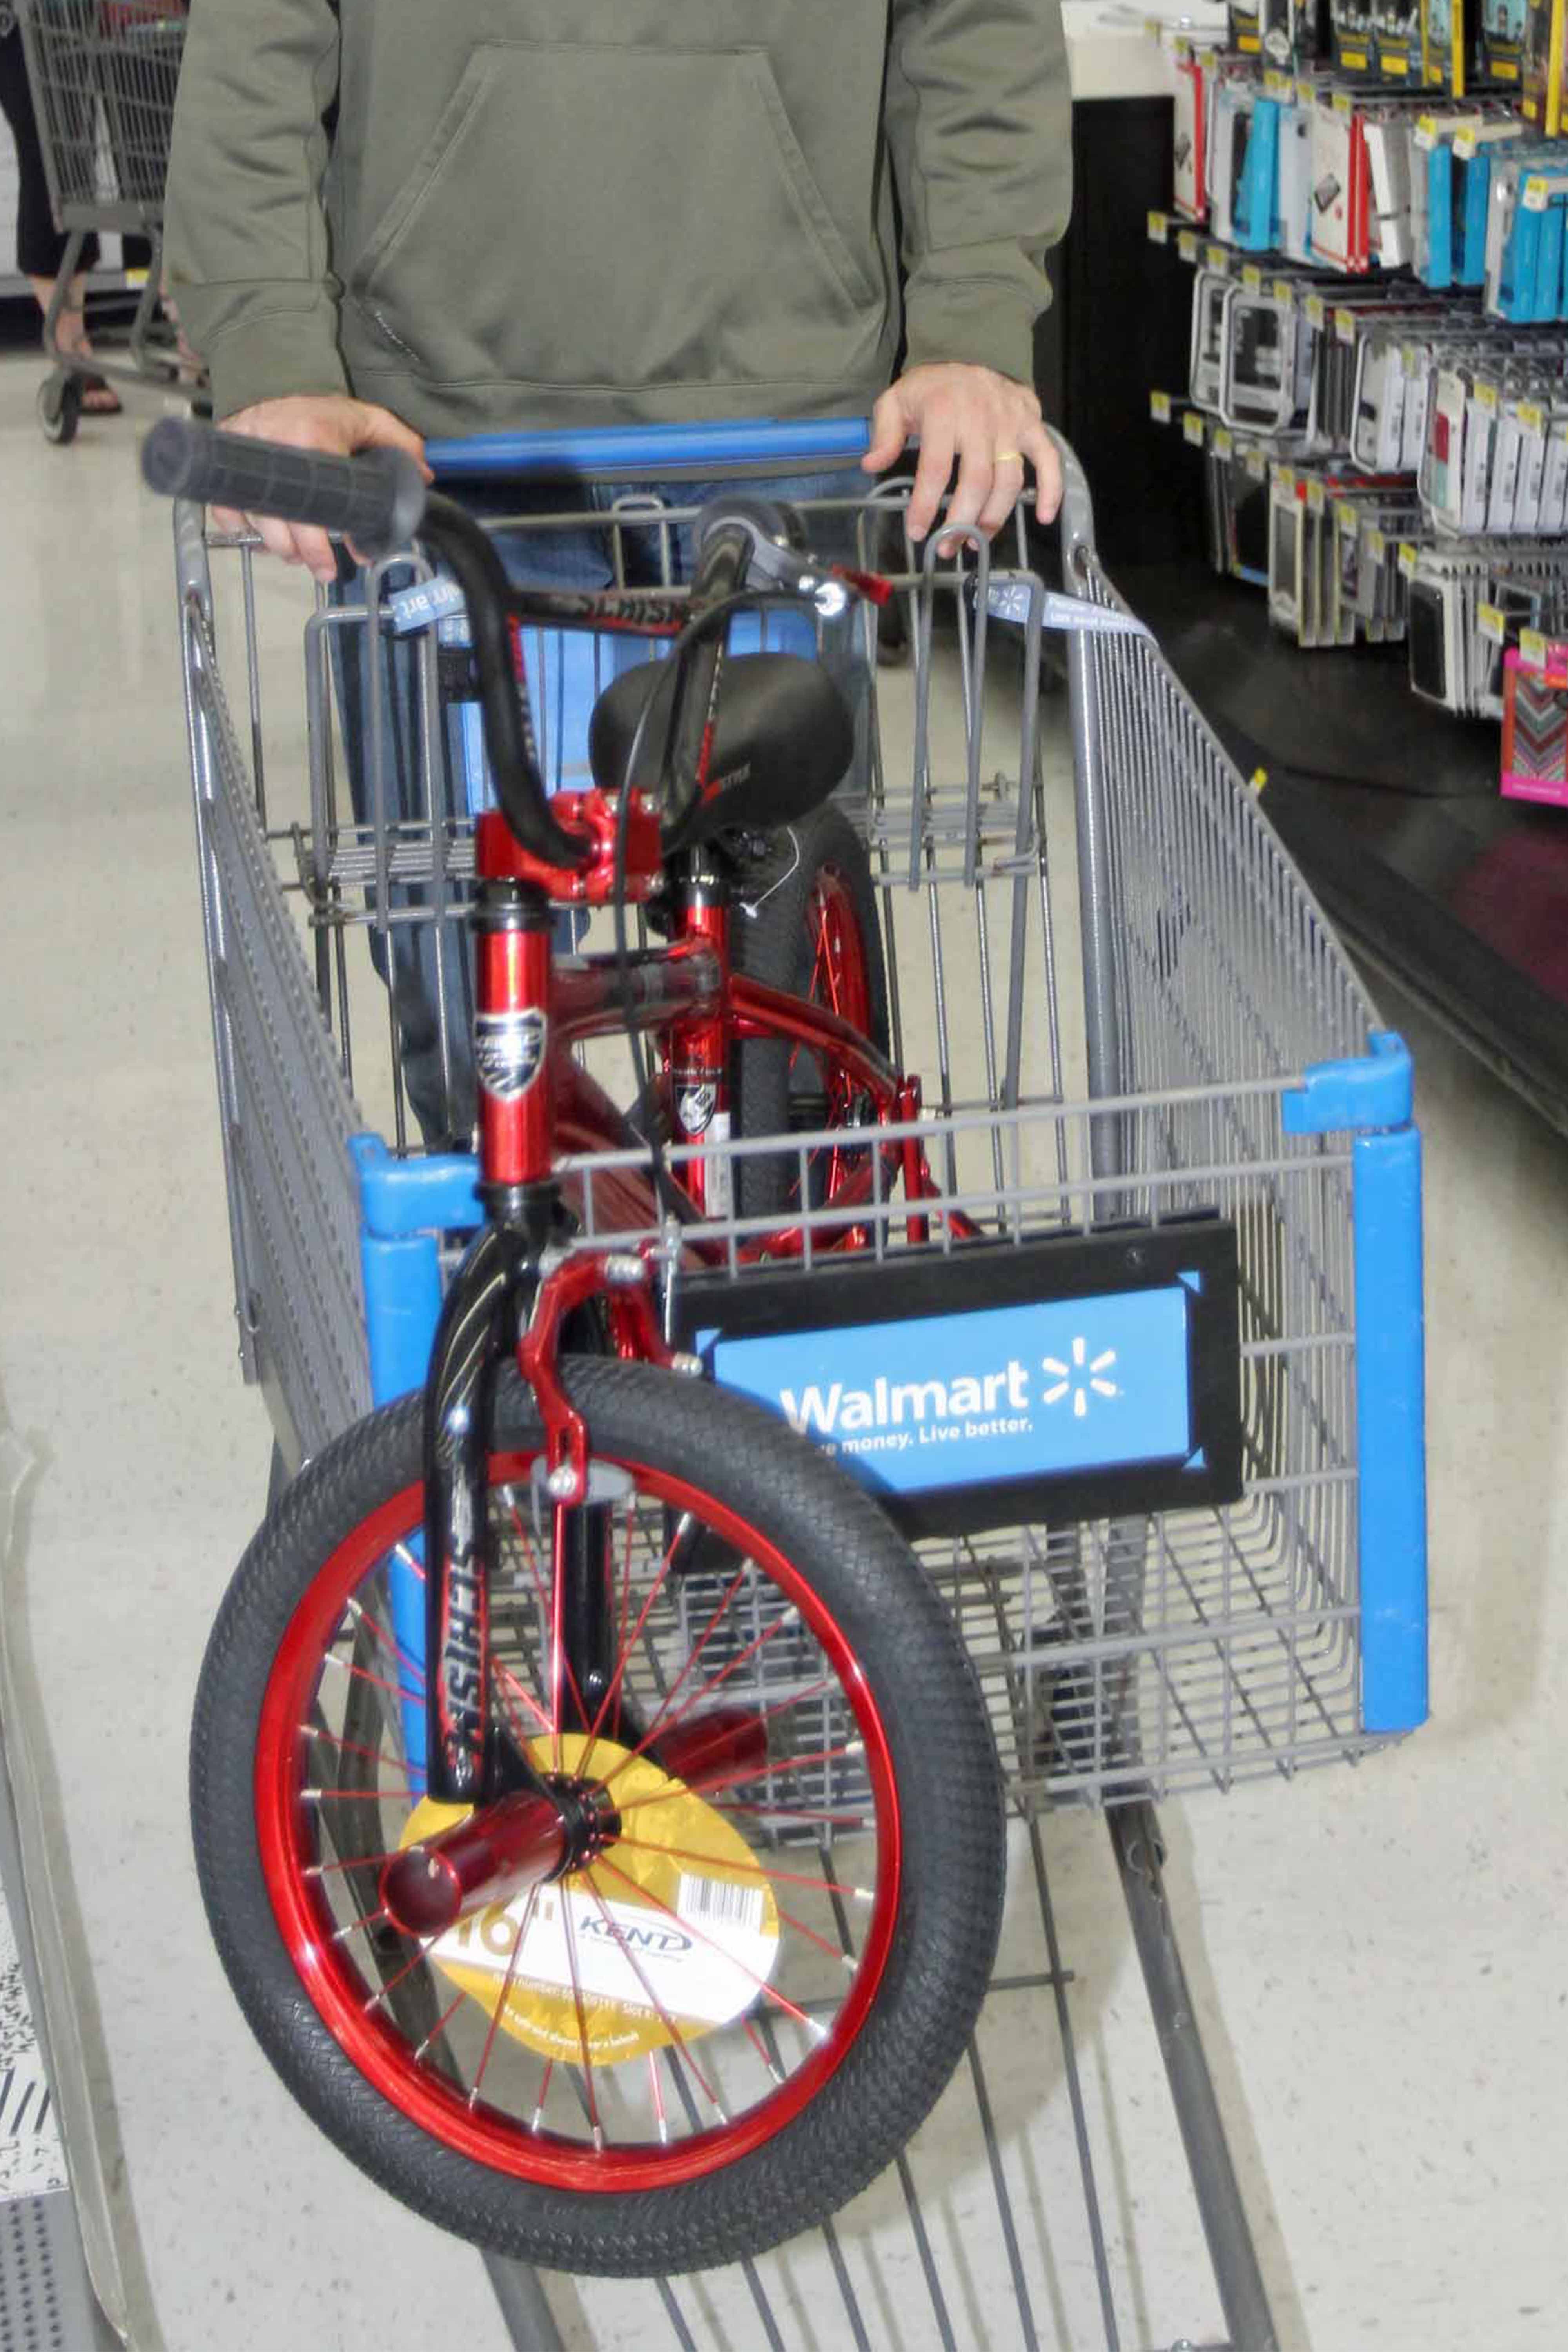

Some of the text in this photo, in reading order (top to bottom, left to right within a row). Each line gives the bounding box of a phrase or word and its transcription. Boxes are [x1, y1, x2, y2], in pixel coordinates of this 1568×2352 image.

[779, 1360, 1029, 1435] Walmart
[842, 1431, 913, 1453] money.
[919, 1423, 960, 1443] Live
[965, 1416, 1033, 1439] better.
